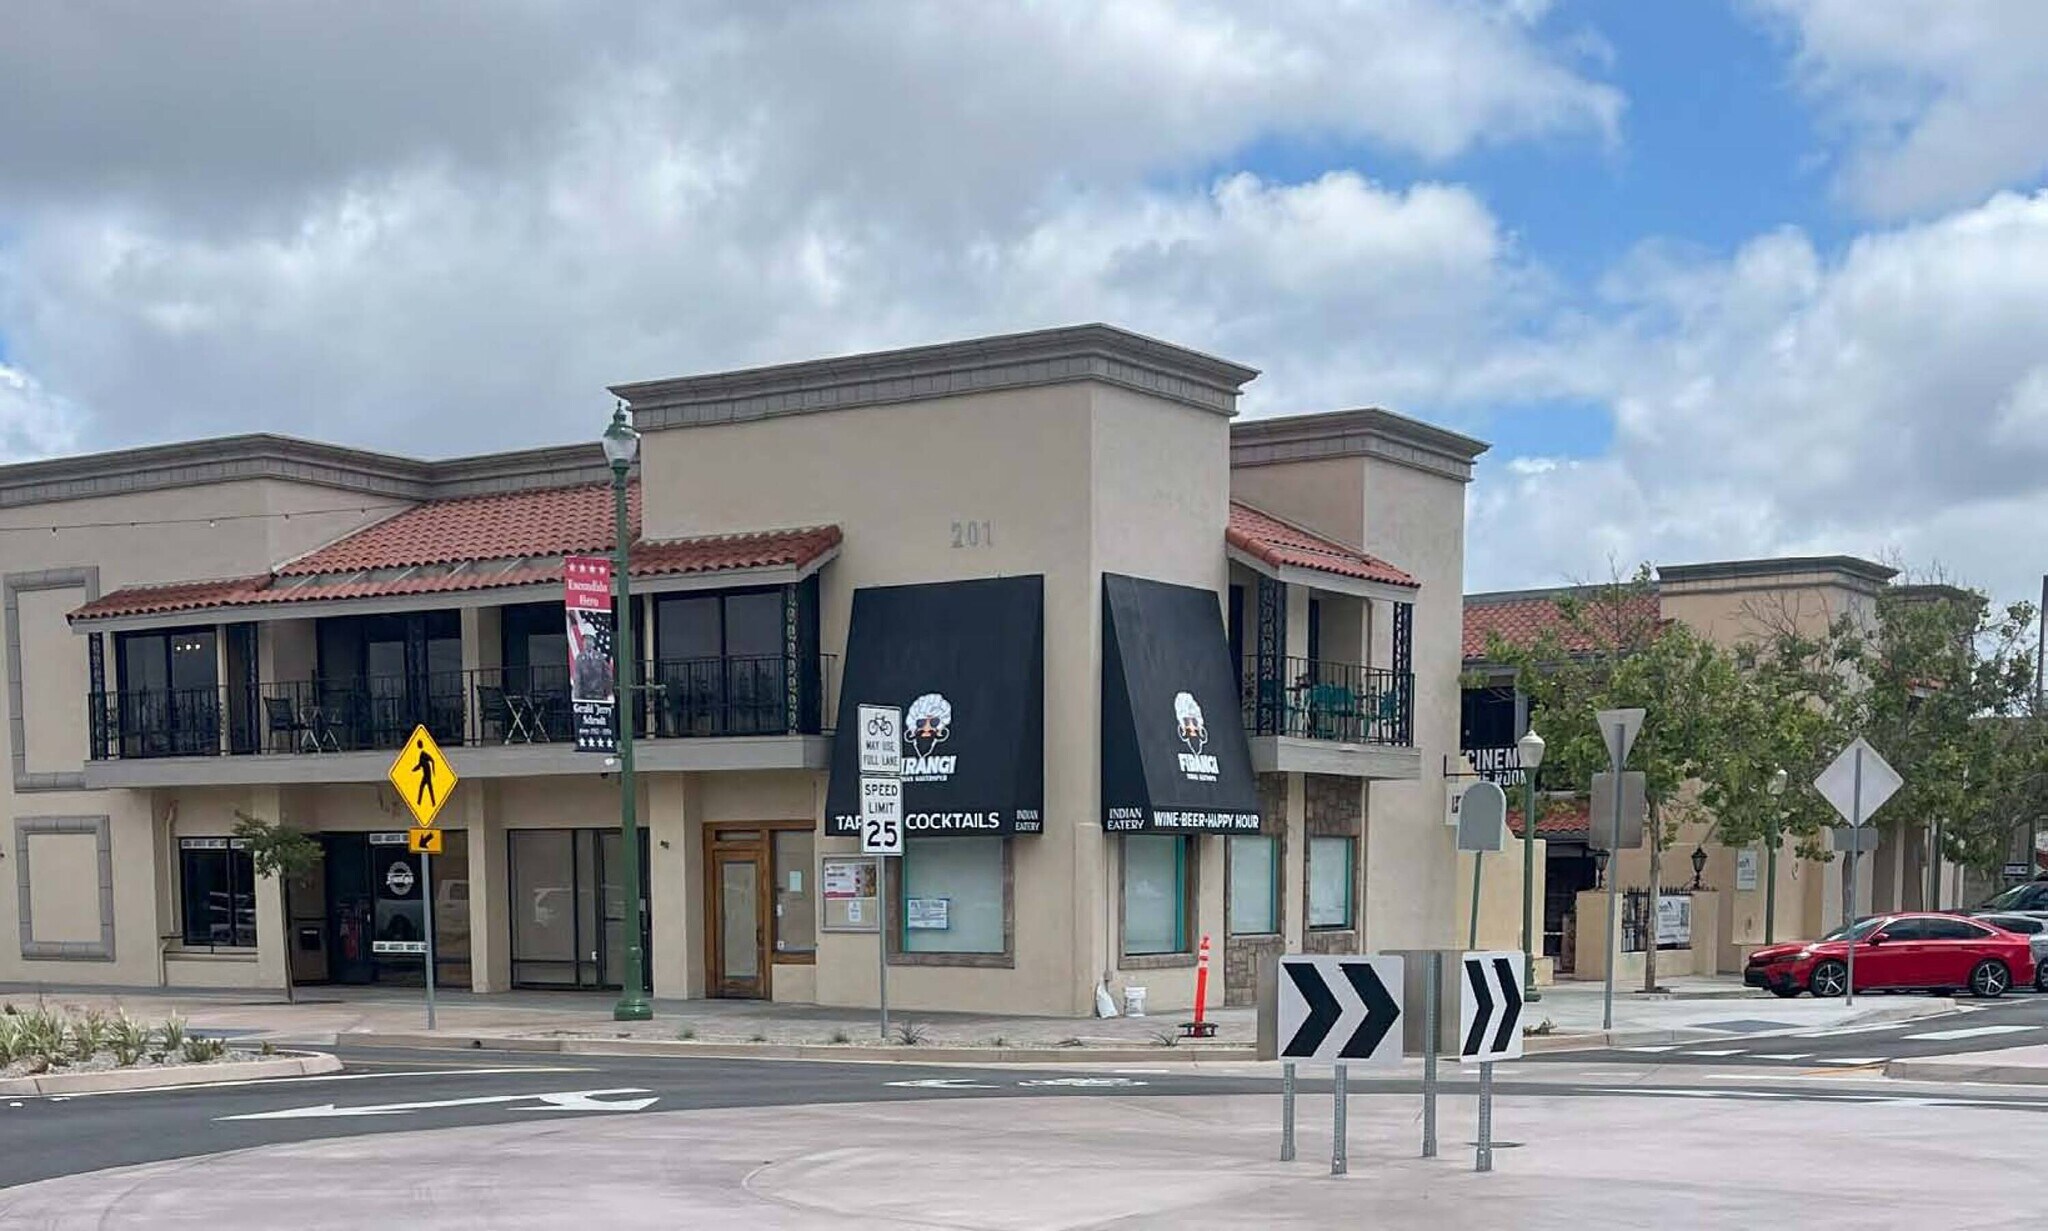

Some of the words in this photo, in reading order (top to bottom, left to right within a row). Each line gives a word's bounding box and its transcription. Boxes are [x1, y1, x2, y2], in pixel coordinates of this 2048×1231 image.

[950, 519, 993, 548] 201
[580, 595, 599, 606] Hero
[866, 741, 880, 750] MAY
[882, 741, 896, 752] USE
[863, 755, 879, 765] FULL
[881, 756, 898, 766] LANE
[901, 755, 957, 775] IRANGI
[1465, 748, 1522, 770] CINEM
[865, 783, 898, 796] SPEED
[868, 802, 895, 814] LIMIT
[1109, 807, 1143, 819] INDIAN
[1016, 809, 1039, 820] INDIAN
[905, 812, 1000, 830] COCKTAILS
[1015, 821, 1040, 831] EATERY
[1107, 819, 1145, 830] EATERY
[1235, 814, 1259, 829] HOUR
[867, 820, 898, 847] 25
